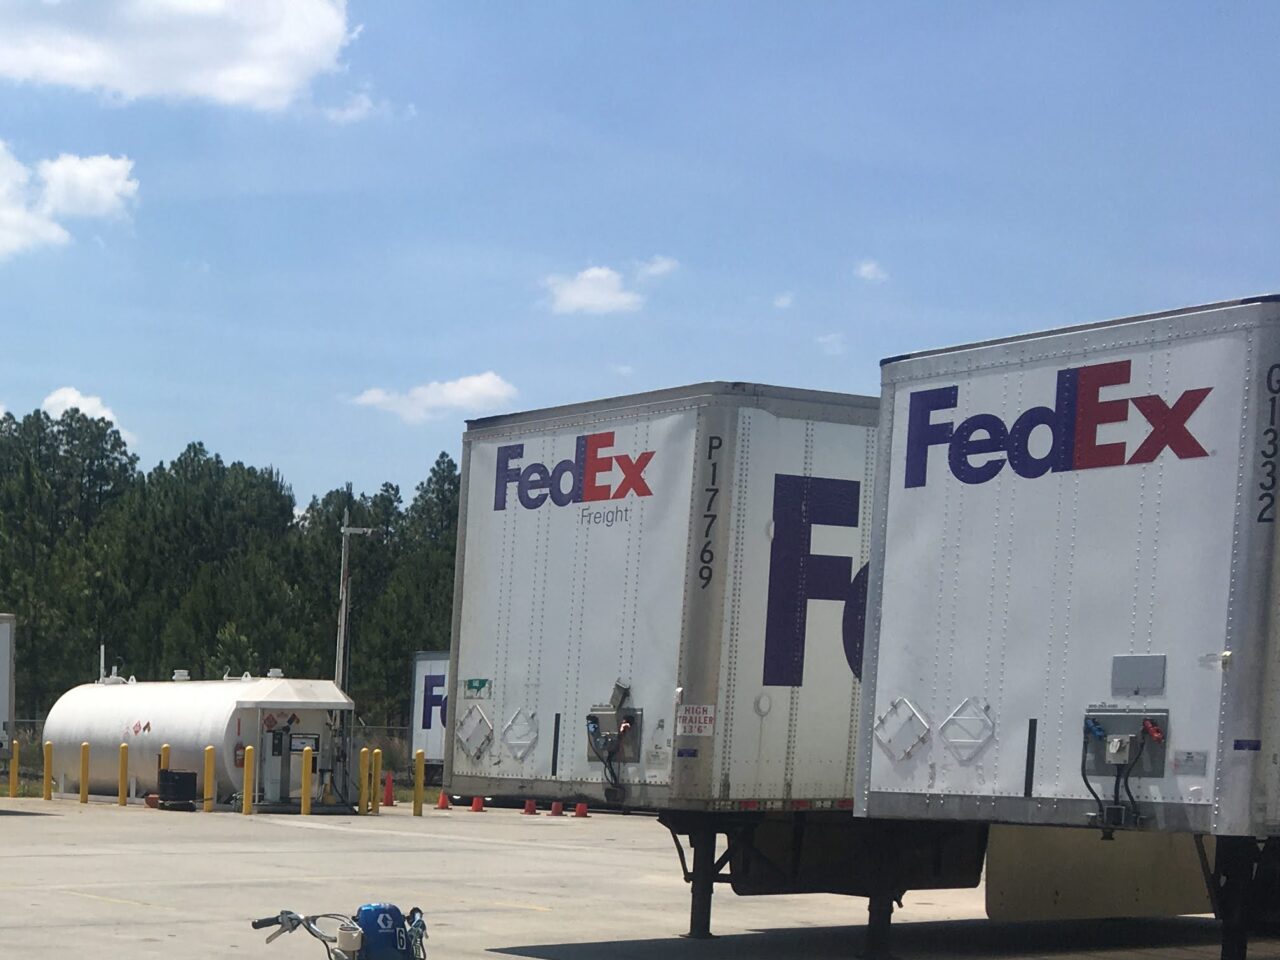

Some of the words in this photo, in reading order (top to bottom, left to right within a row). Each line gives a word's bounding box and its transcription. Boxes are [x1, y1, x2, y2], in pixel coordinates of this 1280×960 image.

[904, 359, 1214, 488] FedEx
[494, 432, 656, 511] FedEx
[580, 505, 629, 527] Freight
[699, 436, 722, 590] P17769
[763, 473, 869, 687] F
[422, 675, 448, 729] F
[678, 715, 714, 725] TRAILER
[684, 706, 708, 715] HIGH
[398, 929, 406, 949] 6
